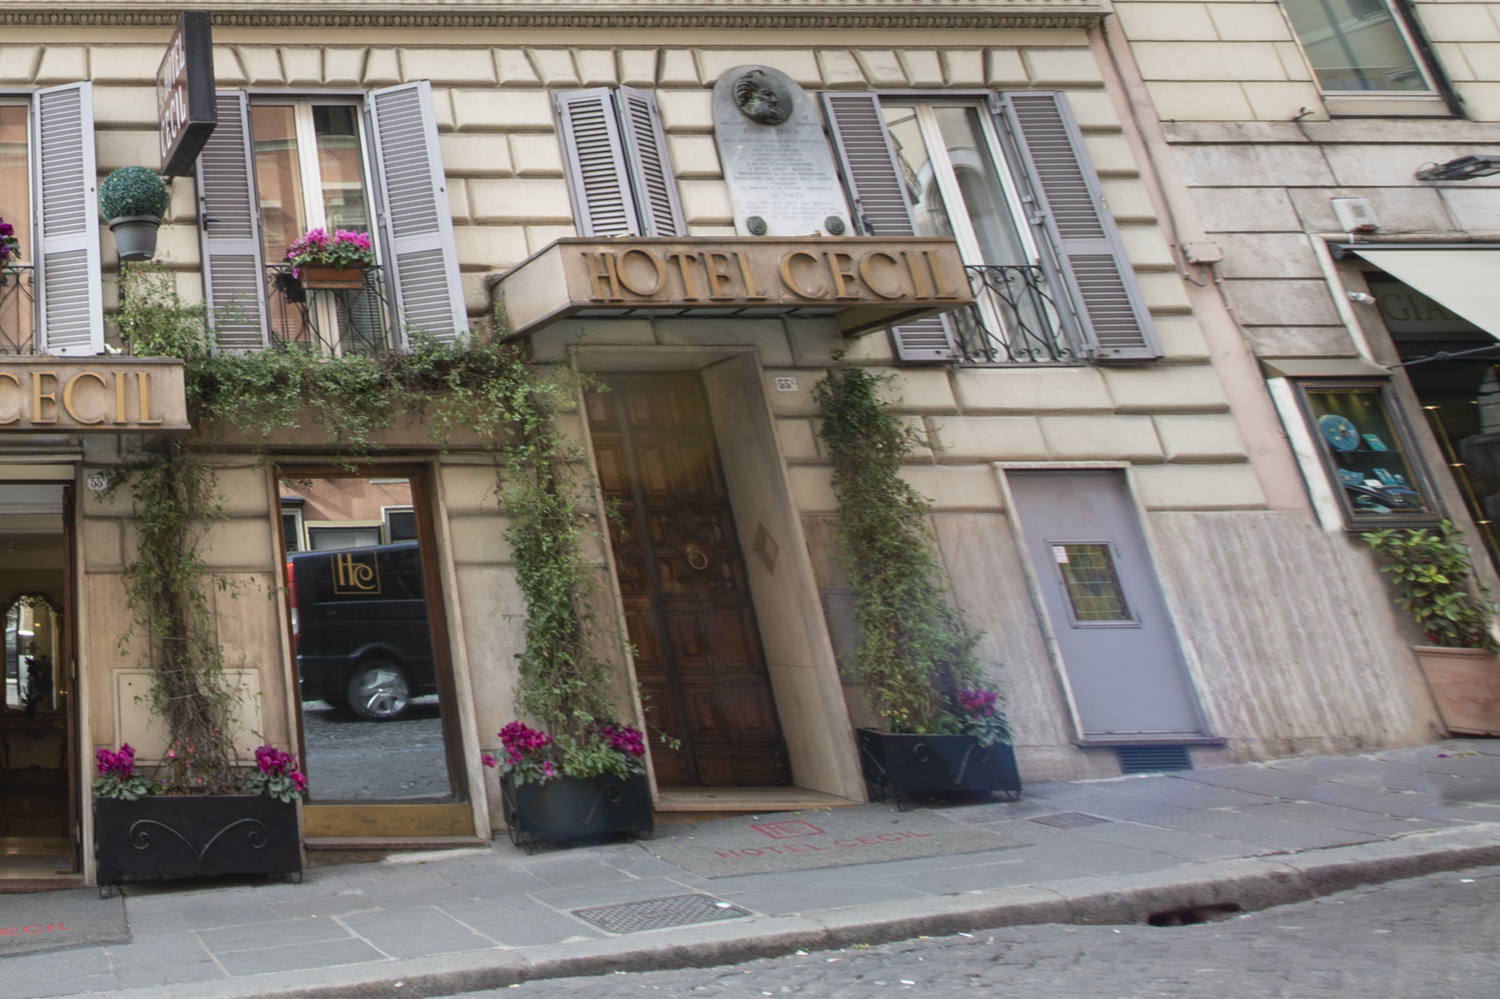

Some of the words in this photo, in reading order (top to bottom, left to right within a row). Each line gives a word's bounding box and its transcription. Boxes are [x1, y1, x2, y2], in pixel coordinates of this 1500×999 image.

[163, 32, 186, 102] HOTEL
[160, 85, 187, 158] CECIL
[581, 248, 768, 302] HOTEL
[779, 250, 959, 300] CECIL
[1380, 293, 1464, 322] GIA
[713, 842, 830, 859] HOTEL
[833, 830, 936, 849] CECIL
